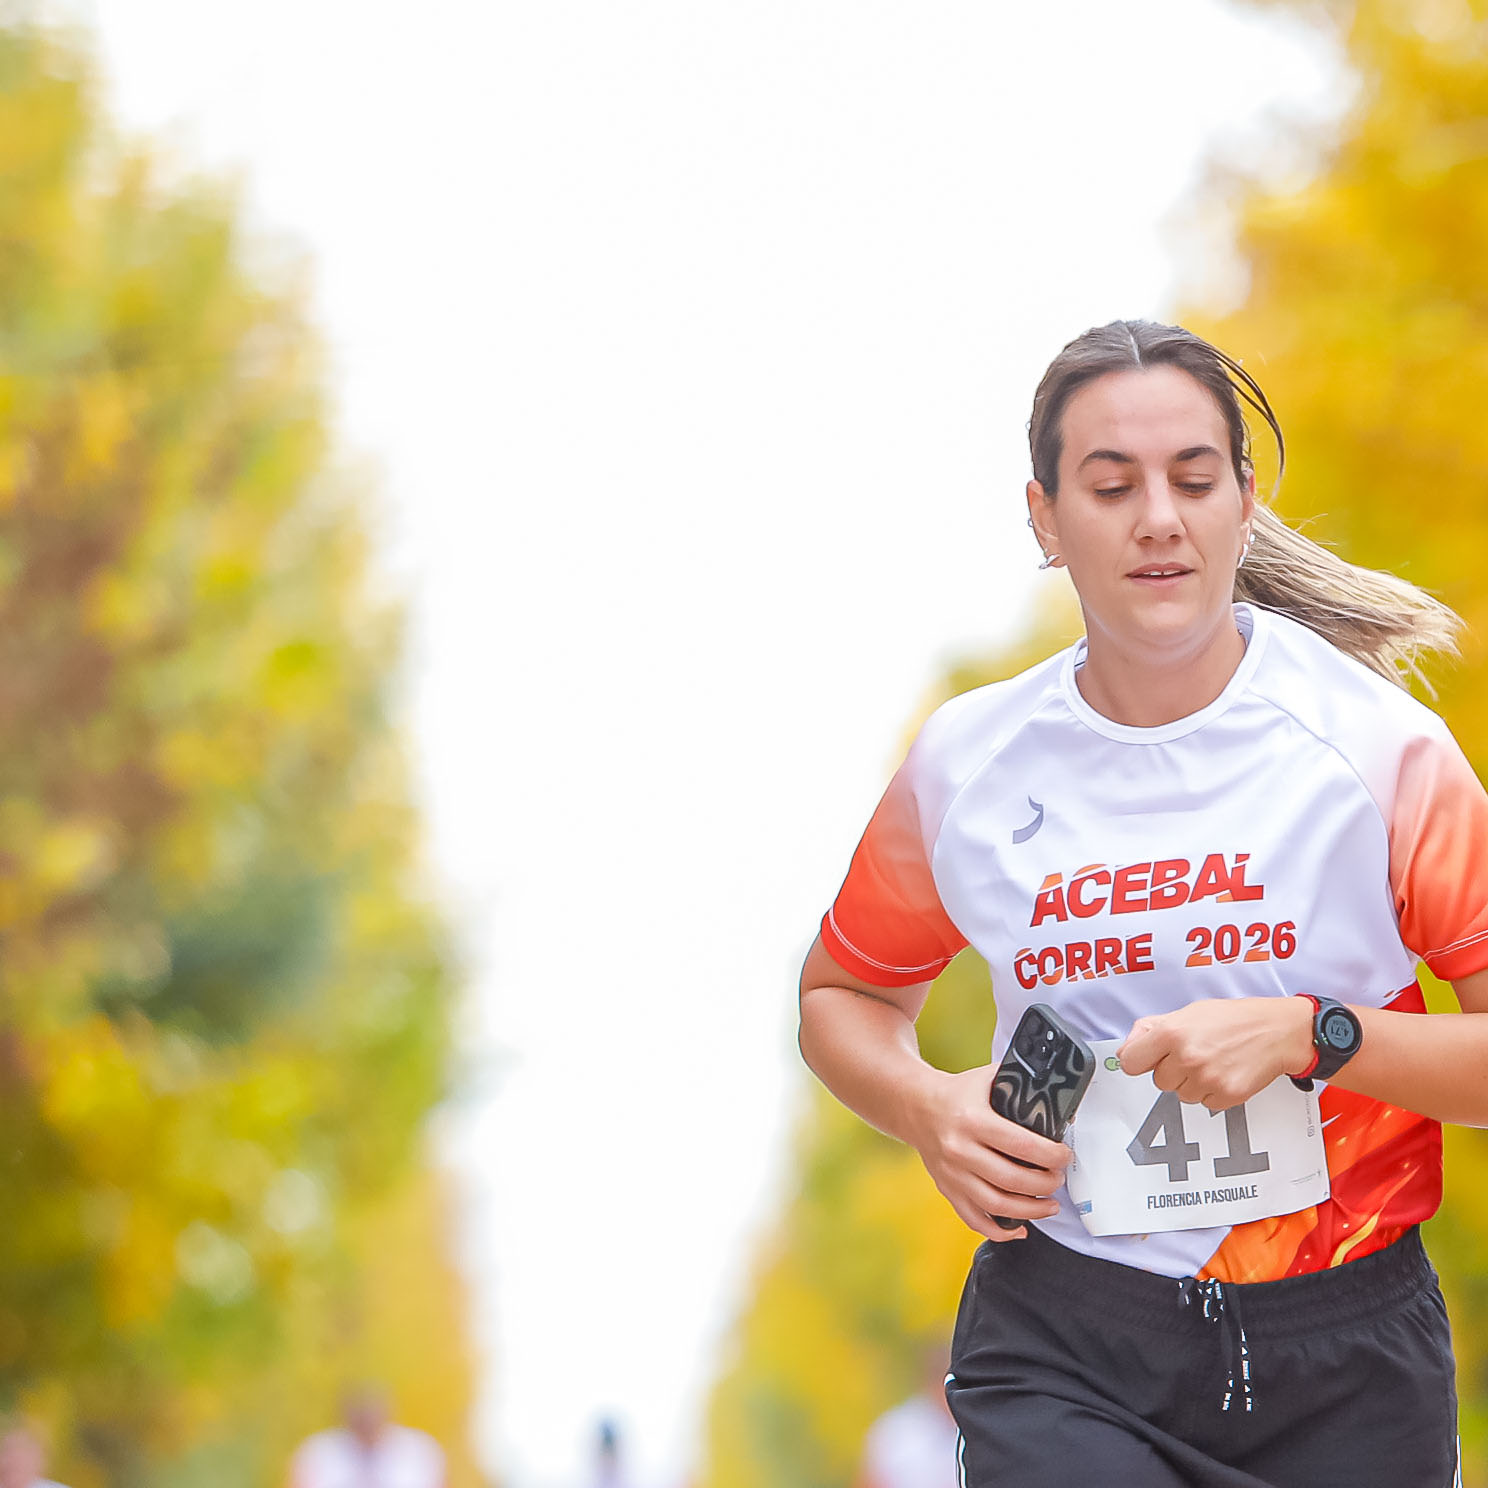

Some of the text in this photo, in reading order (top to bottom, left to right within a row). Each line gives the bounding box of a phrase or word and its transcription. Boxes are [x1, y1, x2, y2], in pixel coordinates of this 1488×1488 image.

[1030, 853, 1264, 927] ACEBAL
[1014, 920, 1296, 990] CORRE 2026
[1126, 1091, 1270, 1182] 41
[1147, 1184, 1258, 1209] FLORENCIA PASQUALE
